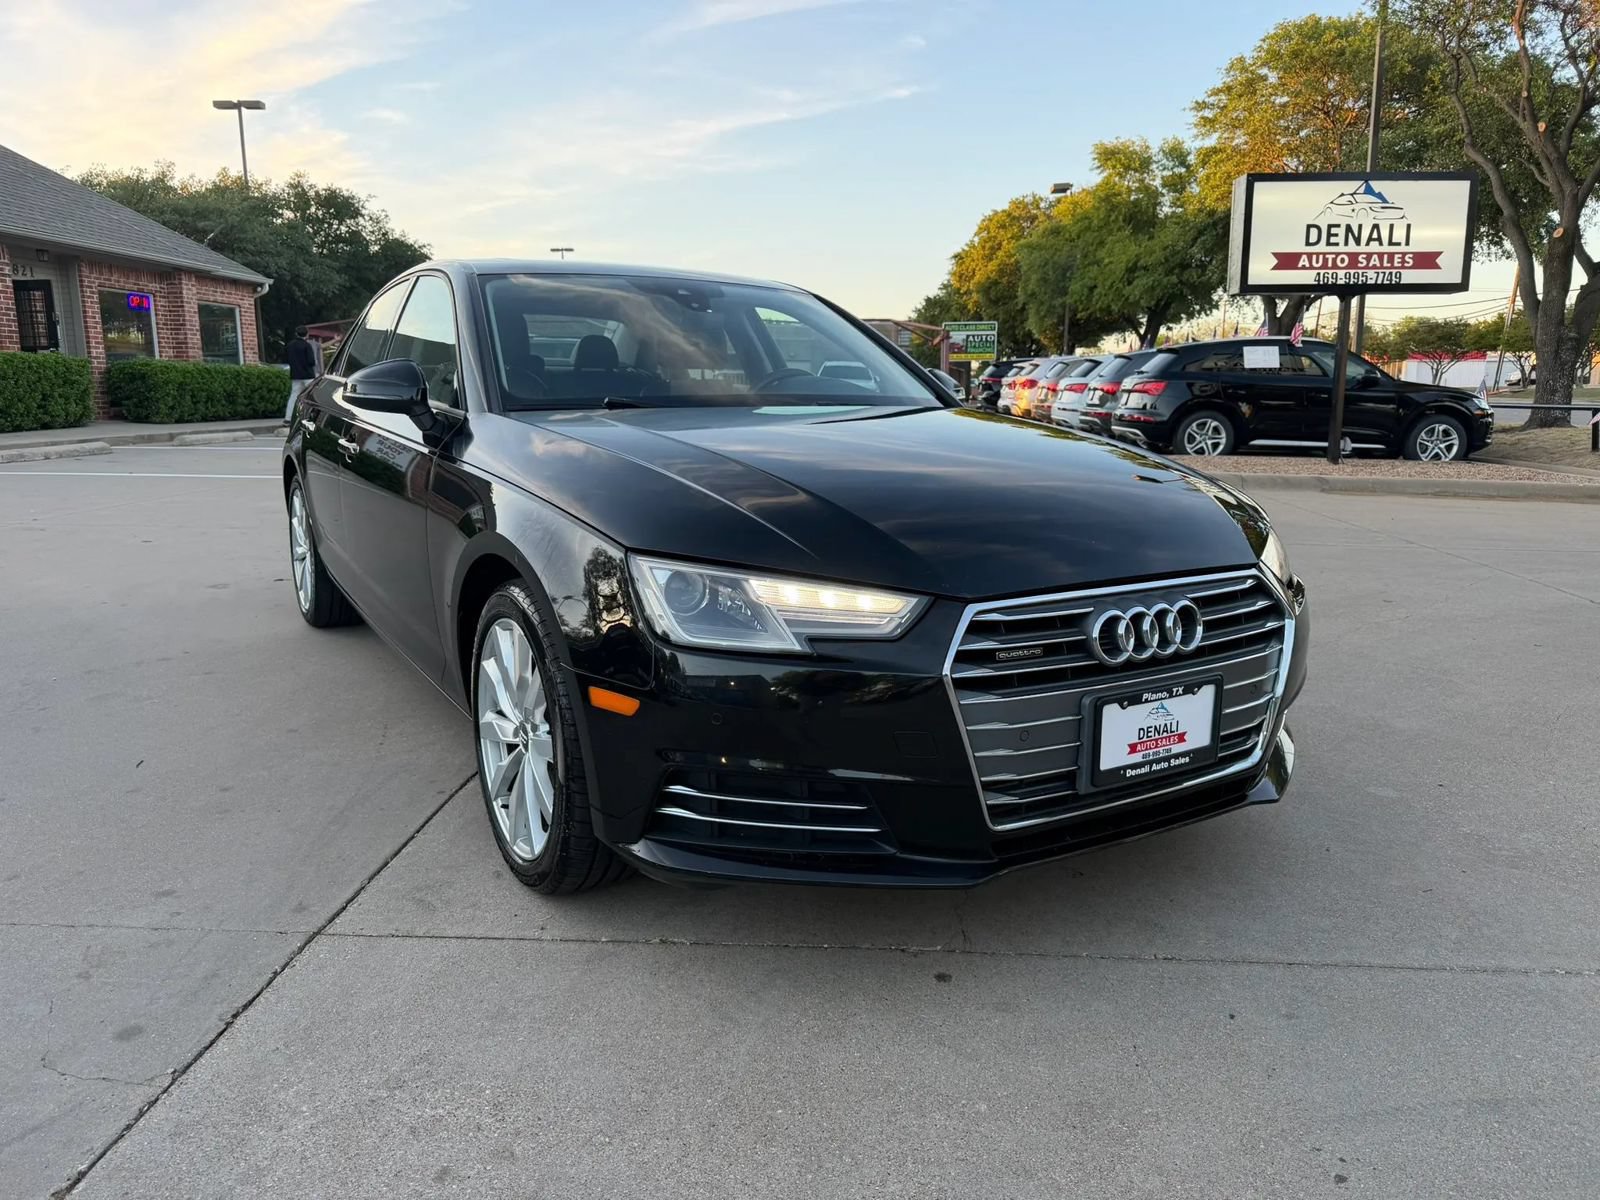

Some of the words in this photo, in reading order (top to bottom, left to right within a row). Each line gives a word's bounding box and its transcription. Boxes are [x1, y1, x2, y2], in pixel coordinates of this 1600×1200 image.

[1304, 223, 1412, 247] DENALI
[1298, 254, 1350, 268] AUTO
[1358, 253, 1414, 267] SALES
[12, 264, 35, 278] 821
[1313, 271, 1402, 285] 469-995-7749
[998, 649, 1042, 659] quattro
[1141, 692, 1170, 702] Plano,
[1172, 686, 1185, 696] TX
[1137, 720, 1179, 740] DENALI
[1136, 740, 1156, 752] AUTO
[1157, 735, 1179, 748] SALES
[1126, 766, 1150, 777] Denali
[1151, 761, 1169, 771] Auto
[1170, 756, 1190, 767] Sales
